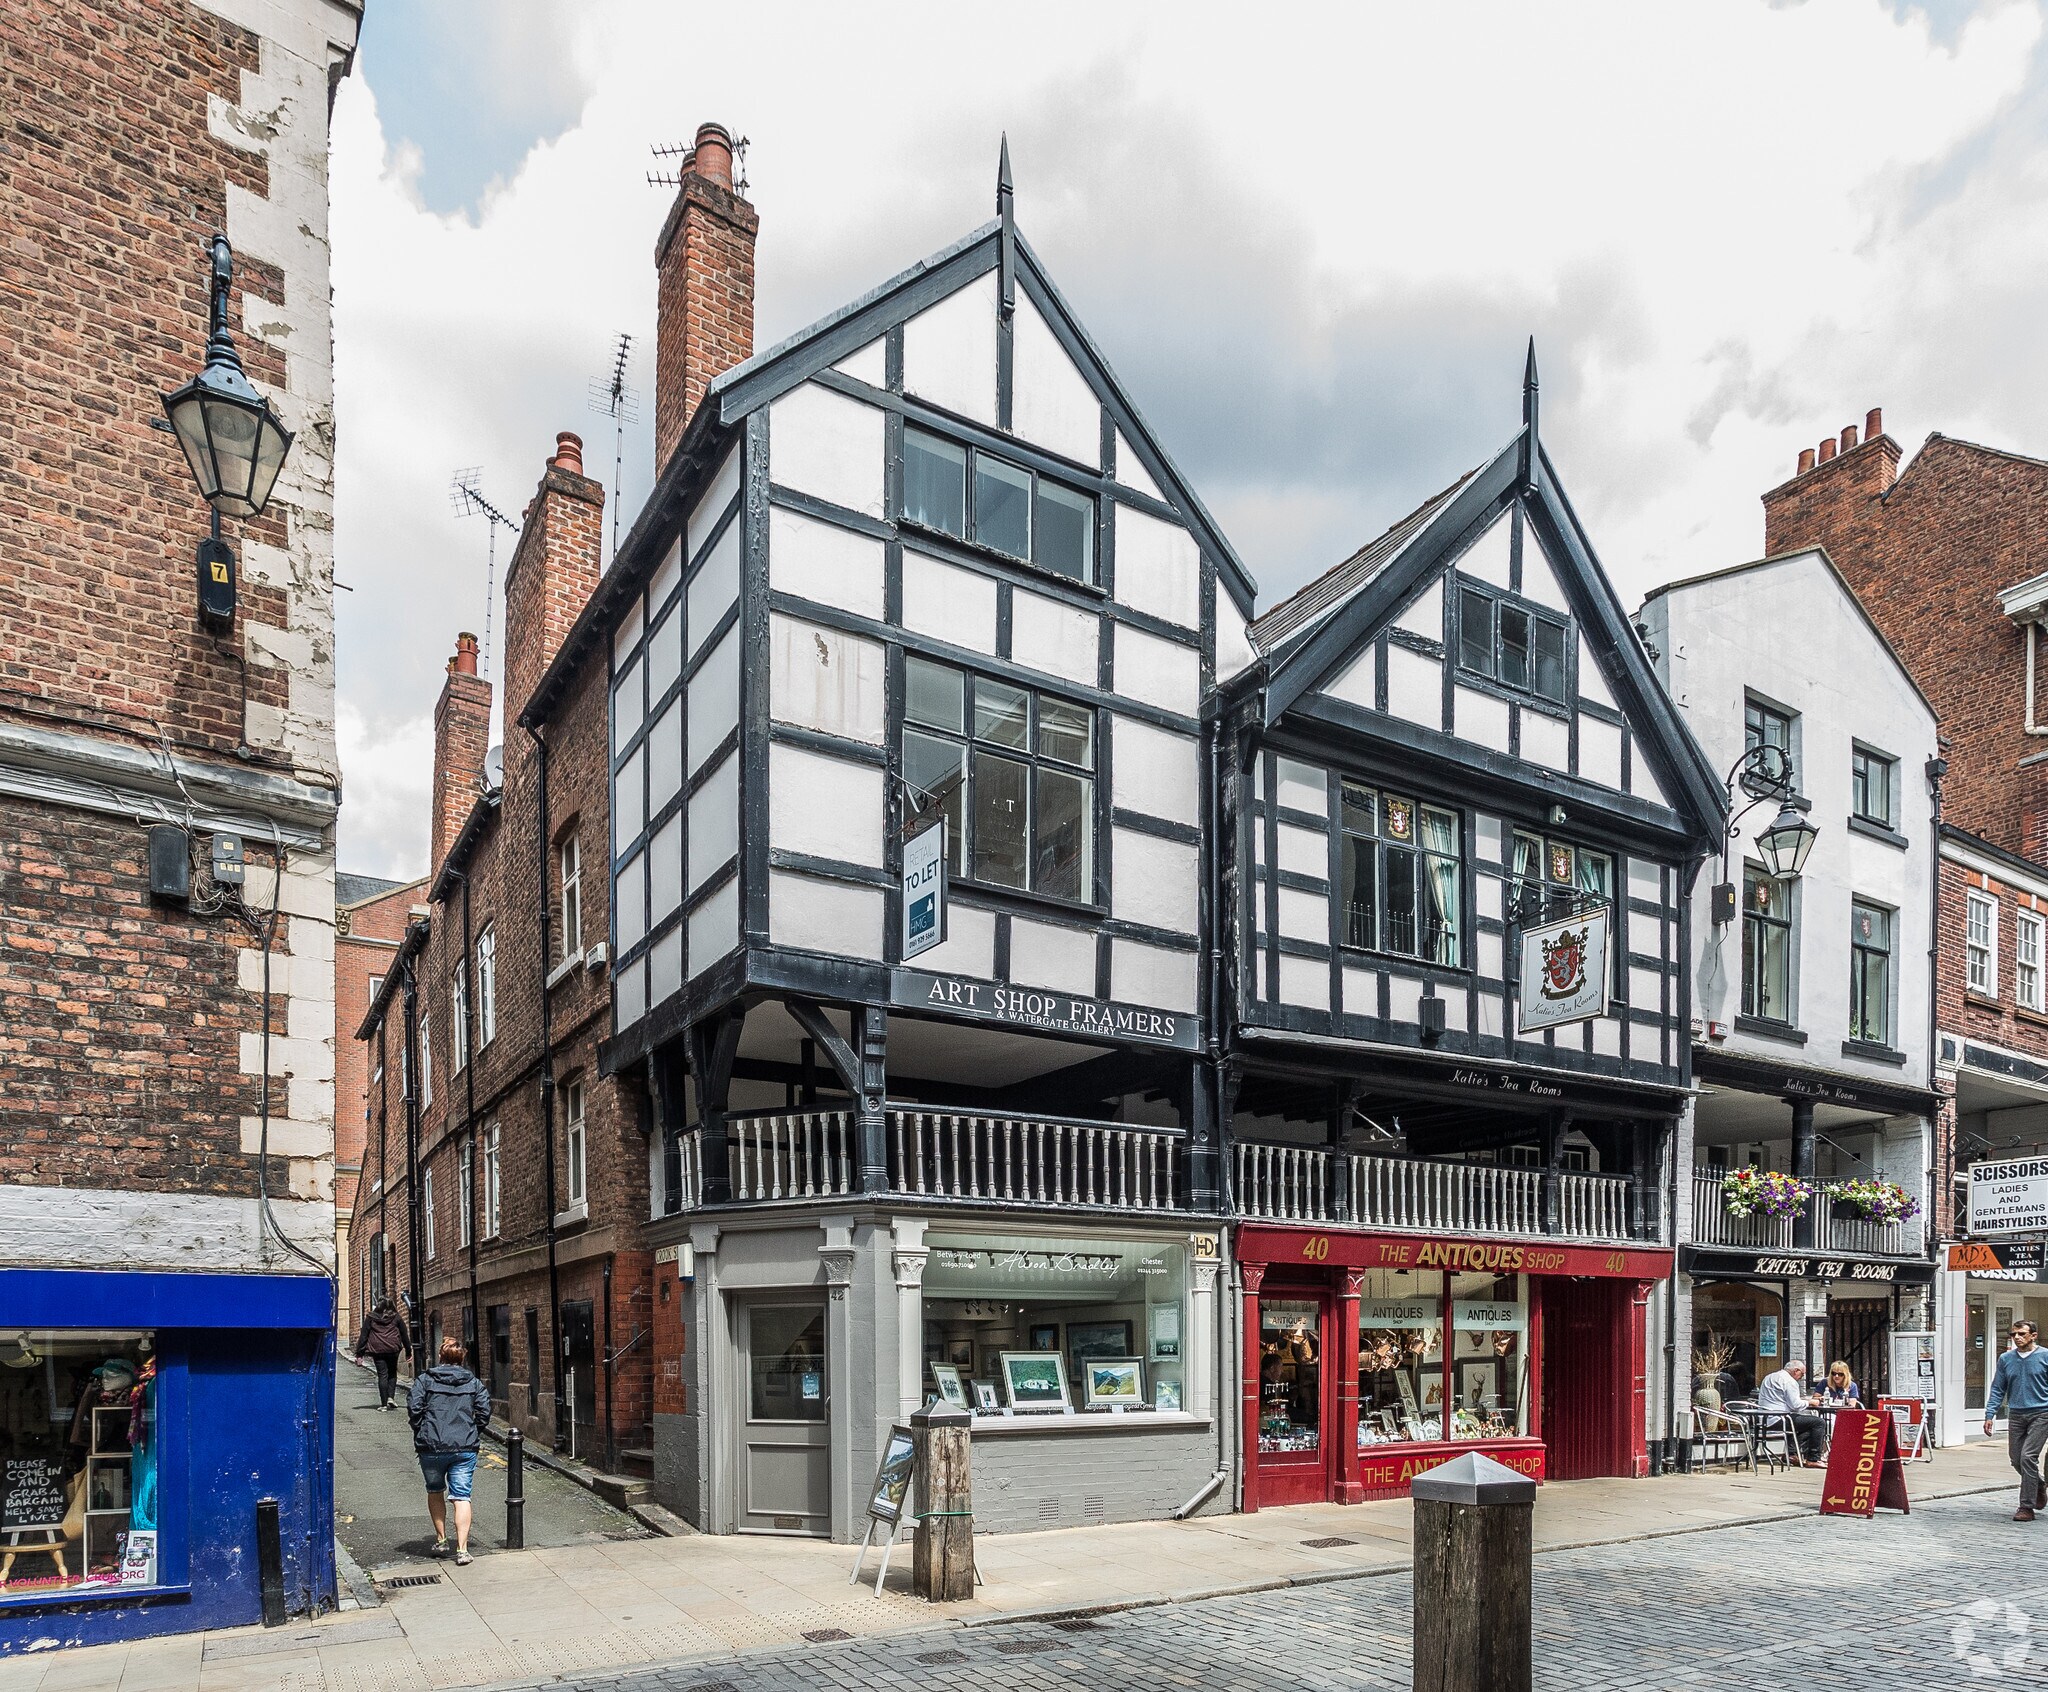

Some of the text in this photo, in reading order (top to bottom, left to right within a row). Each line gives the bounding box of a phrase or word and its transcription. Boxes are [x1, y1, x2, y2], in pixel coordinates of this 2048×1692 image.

[213, 564, 225, 580] 7
[909, 842, 934, 868] RETAIL
[905, 859, 939, 892] TO LET
[910, 915, 927, 934] HMG
[927, 979, 1175, 1037] ART SHOP FRAMERS
[1527, 990, 1598, 1016] Katie's Tea Rooms
[996, 1010, 1116, 1036] & WATERGATE GALLERY
[1449, 1069, 1562, 1097] Katie's Tea Rooms
[1783, 1078, 1857, 1101] Katie's Tea Rooms
[1973, 1161, 2048, 1182] SCISSORS
[1992, 1184, 2029, 1195] LADIES
[1998, 1195, 2021, 1204] AND
[1975, 1203, 2046, 1217] GENTLEMANS
[1974, 1215, 2047, 1231] HAIRSTYLISTS
[1302, 1236, 1625, 1273] 40 THE ANTIQUES SHOP 40
[2009, 1245, 2040, 1253] KATIES
[998, 1249, 1120, 1279] Alison Bradley
[1141, 1257, 1163, 1265] Chester
[1754, 1257, 1898, 1280] KATIE'S TEA ROOMS
[830, 1289, 845, 1301] 42
[1372, 1306, 1424, 1319] ANTIQUES
[1467, 1309, 1512, 1321] ANTIQUES
[7, 1459, 47, 1469] PLEASE
[1851, 1413, 1881, 1510] ANTIQUES
[6, 1466, 62, 1480] COME IN
[1364, 1466, 1395, 1484] THE
[1504, 1457, 1542, 1474] SHOP
[18, 1476, 50, 1487] AND
[9, 1487, 59, 1499] GRAB A
[6, 1495, 64, 1508] BARGAIN
[5, 1505, 64, 1516] HELP SAVE
[18, 1513, 59, 1523] LIVES
[9, 1574, 81, 1588] VOLUNTEER
